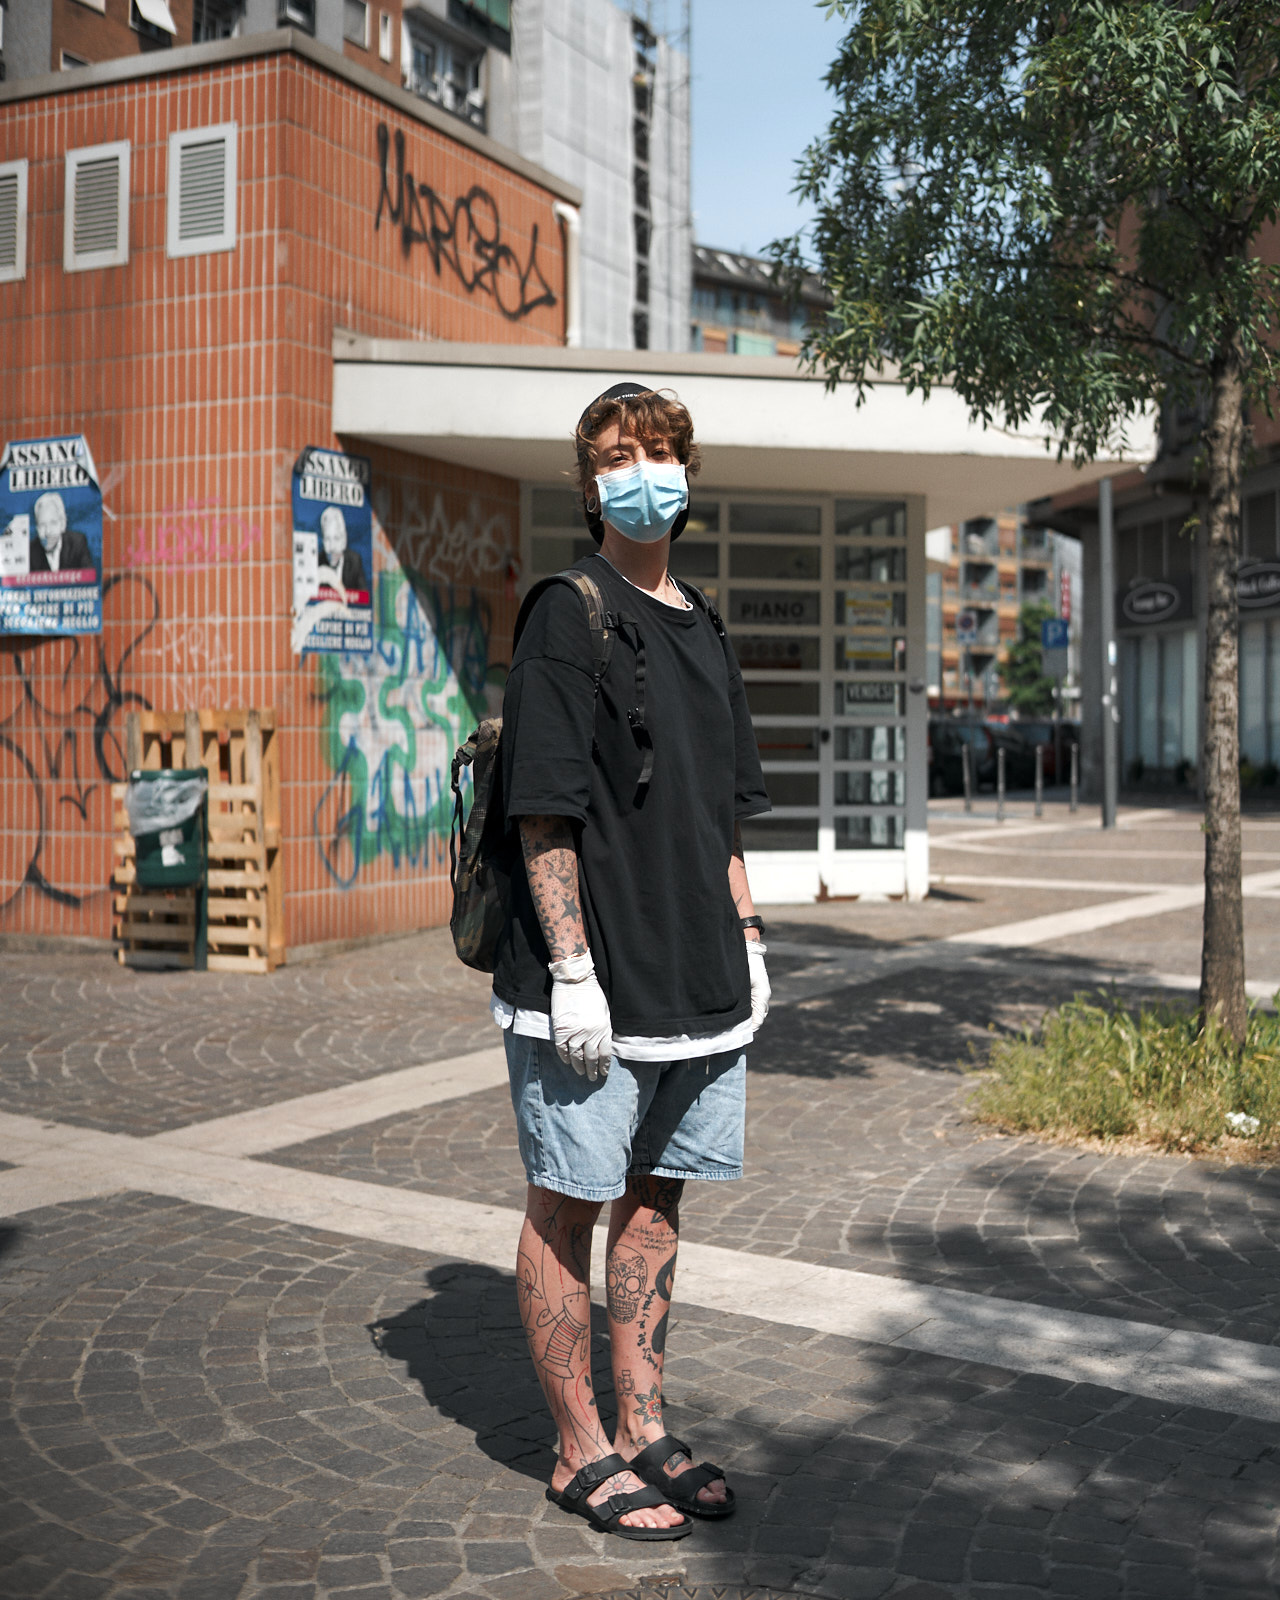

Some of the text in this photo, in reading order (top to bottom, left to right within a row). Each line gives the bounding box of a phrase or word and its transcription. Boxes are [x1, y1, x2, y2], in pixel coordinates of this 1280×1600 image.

[11, 465, 89, 489] LIBERO
[301, 477, 362, 503] LIBERO
[741, 602, 804, 618] PIANO
[62, 614, 99, 629] MEGLIO
[1047, 622, 1063, 643] P
